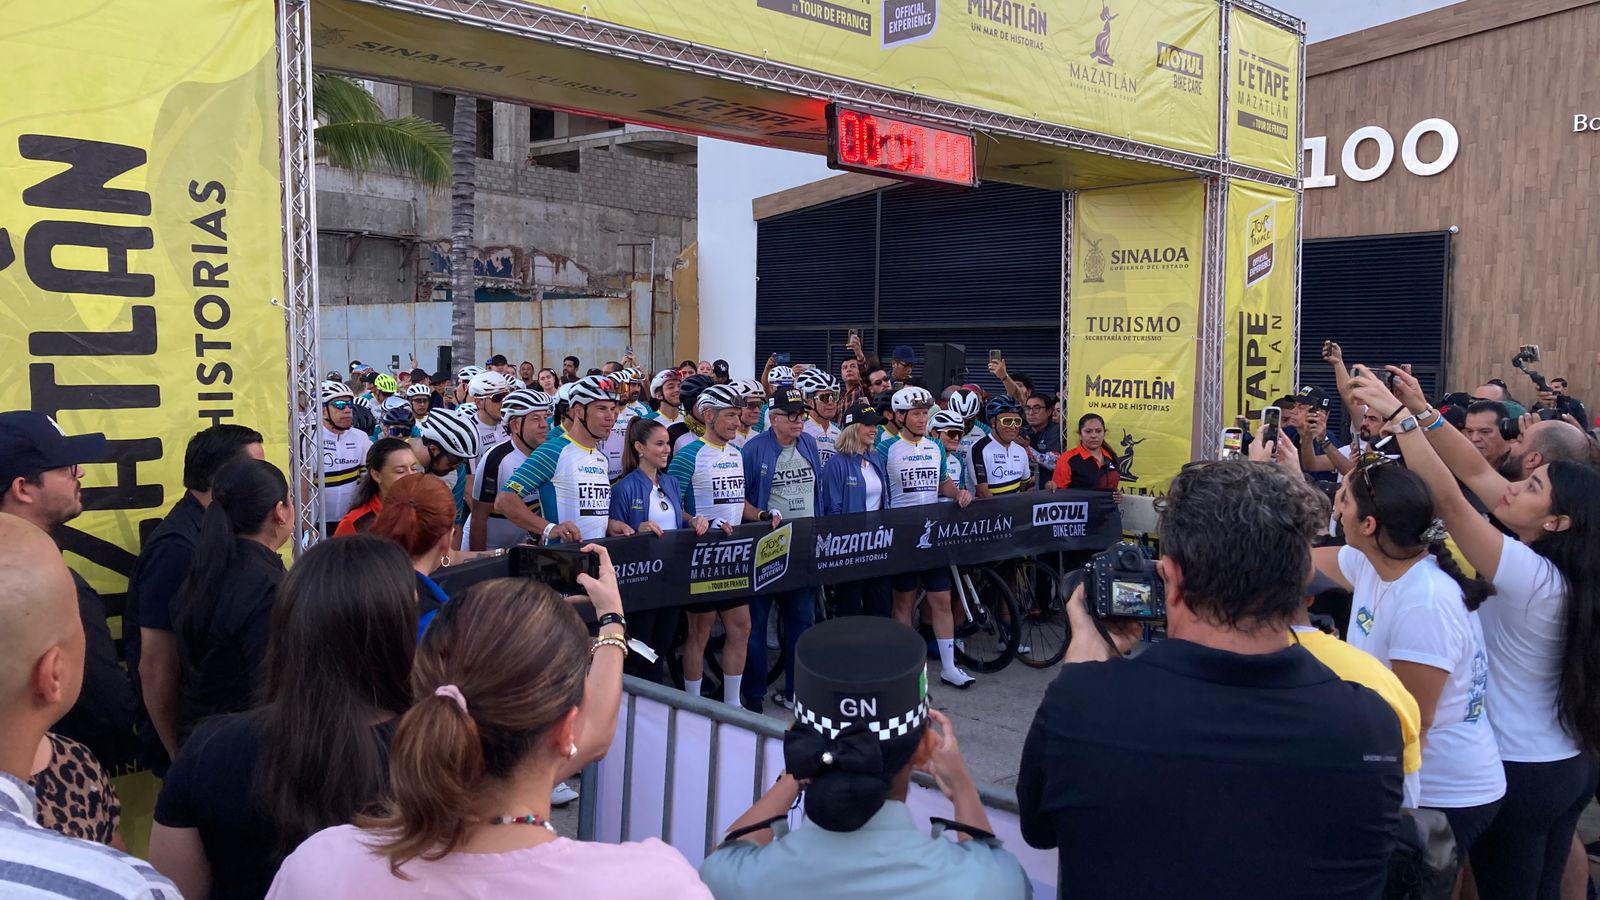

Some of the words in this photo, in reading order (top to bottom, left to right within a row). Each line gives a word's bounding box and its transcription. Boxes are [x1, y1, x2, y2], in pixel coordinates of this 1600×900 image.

[799, 0, 823, 19] TOUR
[824, 6, 835, 22] DE
[836, 10, 869, 31] FRANCE
[894, 2, 926, 19] OFFICIAL
[888, 13, 932, 34] EXPERIENCE
[971, 22, 982, 33] UN
[982, 26, 999, 38] MAR
[1000, 31, 1009, 41] DE
[1010, 34, 1044, 51] HISTORIAS
[354, 41, 505, 73] SINALOA
[1158, 46, 1202, 76] MOTUL
[527, 74, 638, 98] TURISMO
[1069, 61, 1137, 94] MAZATLÁN
[1173, 74, 1187, 92] BIKE
[1187, 78, 1202, 95] CARE
[1238, 90, 1289, 120] MAZATLÁN
[1111, 247, 1189, 264] SINALOA
[1086, 316, 1181, 333] TURISMO
[1085, 373, 1175, 400] MAZATLÁN
[1130, 403, 1170, 412] HISTORIAS
[1035, 504, 1087, 523] MOTUL
[937, 513, 1013, 539] MAZATLÁN
[1053, 524, 1068, 537] BIKE
[1068, 523, 1086, 537] CARE
[815, 525, 894, 558] MAZATLÁN
[612, 558, 663, 578] RISMO
[690, 563, 749, 579] MAZATLÁN
[818, 562, 827, 570] UN
[829, 559, 843, 568] MAR
[845, 558, 853, 566] DE
[855, 552, 888, 563] HISTORIAS
[626, 576, 649, 584] TURISMO
[711, 582, 724, 590] TOUR
[730, 579, 748, 587] FRANCE
[840, 698, 877, 717] GN
